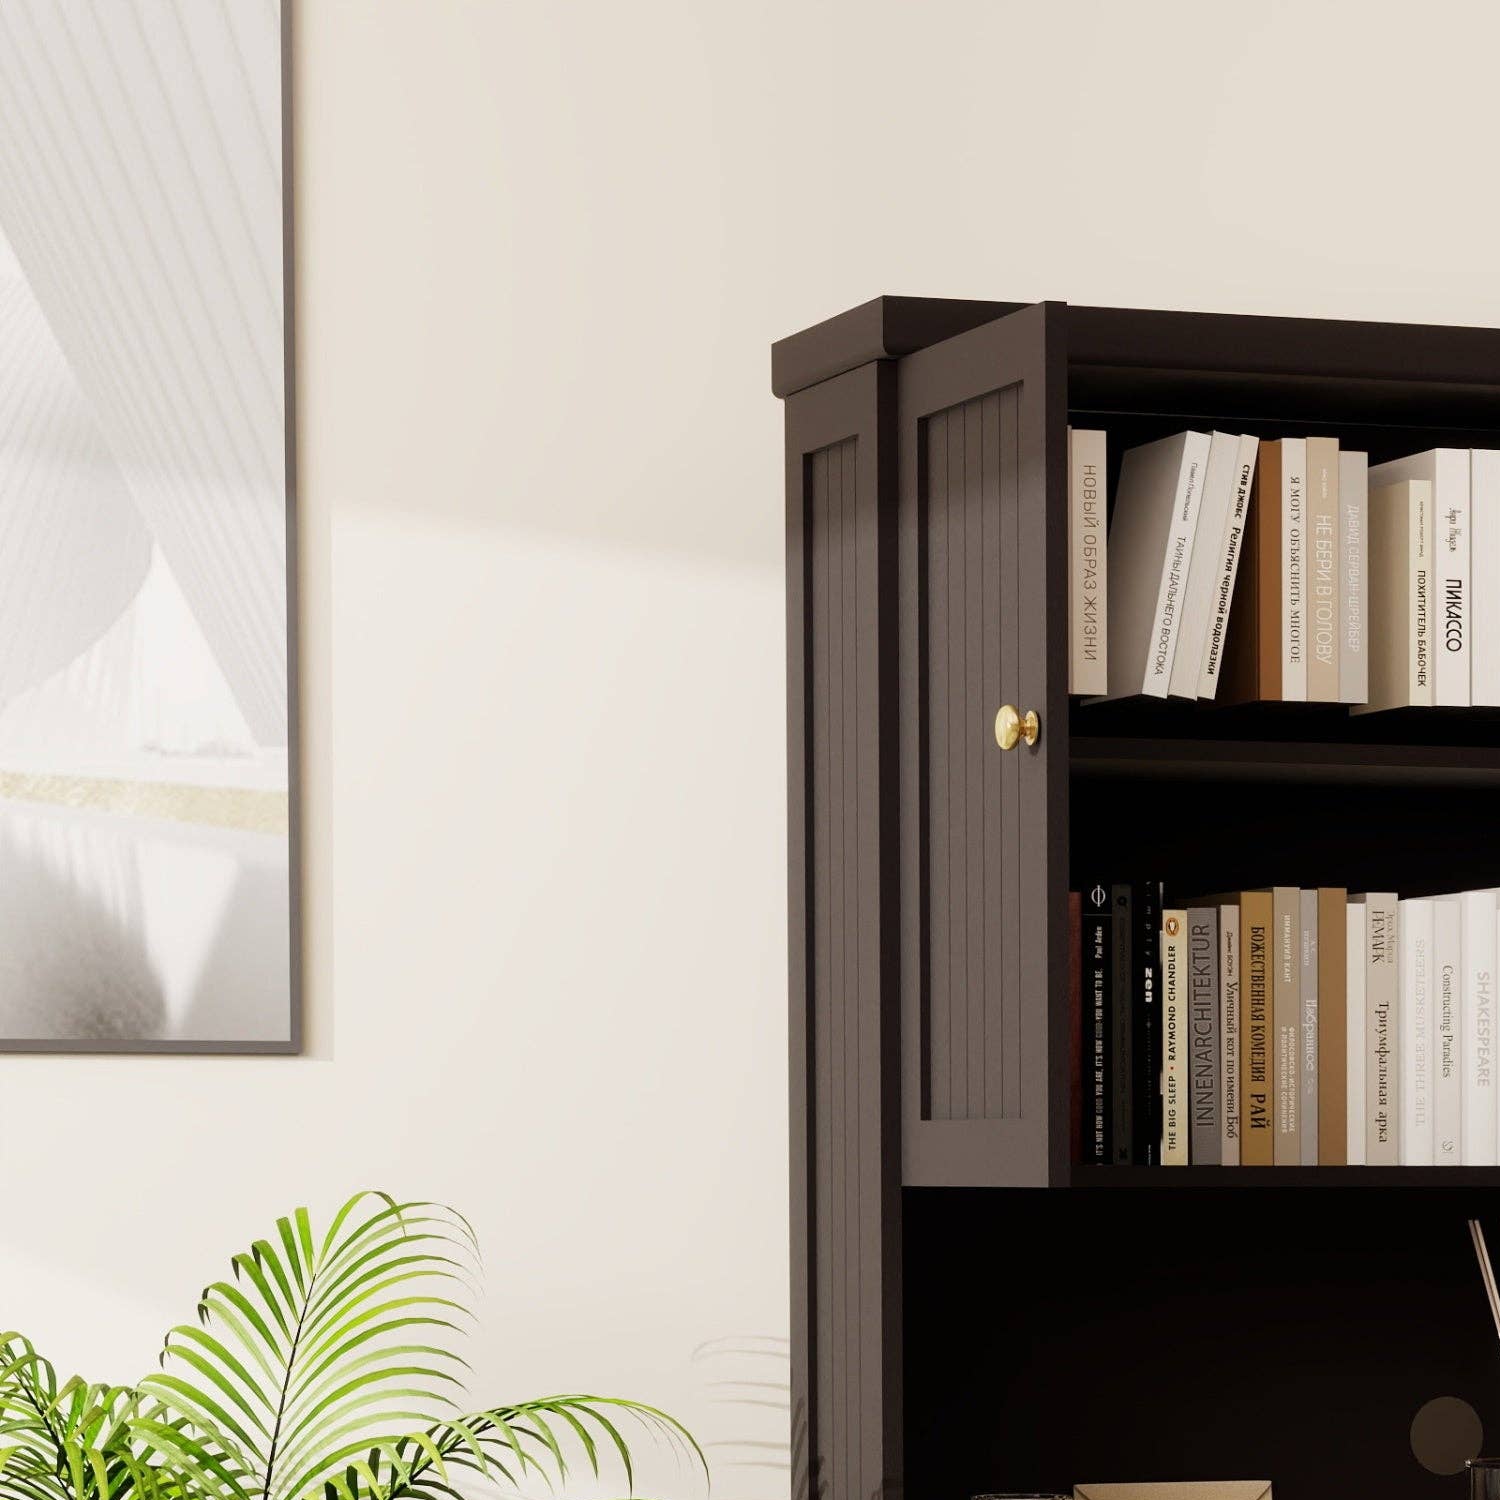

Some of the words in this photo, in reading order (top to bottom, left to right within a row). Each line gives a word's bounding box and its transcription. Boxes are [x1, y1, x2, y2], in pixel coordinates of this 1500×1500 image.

[1083, 464, 1100, 529] НОВЫЙ
[1289, 486, 1301, 522] МОГУ
[1290, 476, 1301, 484] Я
[1315, 514, 1332, 536] НЕ
[1347, 504, 1360, 545] ДАВИД
[1083, 534, 1097, 590] ОБРАЗ
[1289, 528, 1301, 606] ОБЪЯСНИТЬ
[1315, 539, 1332, 581] БЕРИ
[1162, 571, 1179, 626] ДАЛЬНЕГО
[1315, 585, 1332, 595] В
[1417, 570, 1426, 638] ПОХИТИТЕЛЬ
[1083, 596, 1097, 661] ЖИЗНИ
[1289, 609, 1301, 664] МНОГОЕ
[1314, 600, 1332, 664] ГОЛОВУ
[1445, 579, 1463, 652] ПИКАССО
[1154, 627, 1171, 676] ВОСТОКА
[1417, 639, 1426, 687] БАБОЧЕК
[1144, 967, 1153, 1003] zen
[1167, 944, 1176, 1002] CHANDLER
[1250, 926, 1265, 1021] БОЖЕСТВЕННАЯ
[1225, 982, 1239, 1034] Уличный
[1440, 965, 1454, 1032] Constructing
[1167, 1005, 1176, 1061] RAYMOND
[1191, 924, 1214, 1127] INNENARCHITEKTUR
[1226, 1037, 1236, 1056] кот
[1477, 971, 1490, 1087] SHAKESPEARE
[1226, 1059, 1236, 1074] по
[1250, 1025, 1265, 1082] КОМЕДИЯ
[1374, 1001, 1390, 1106] Триумфальная
[1167, 1075, 1176, 1105] SLEEP
[1226, 1075, 1236, 1113] имени
[1250, 1093, 1270, 1129] РАЙ
[1167, 1108, 1176, 1128] BIG
[1167, 1131, 1176, 1151] THE
[1226, 1116, 1239, 1138] Боб
[1374, 1110, 1387, 1143] арка
